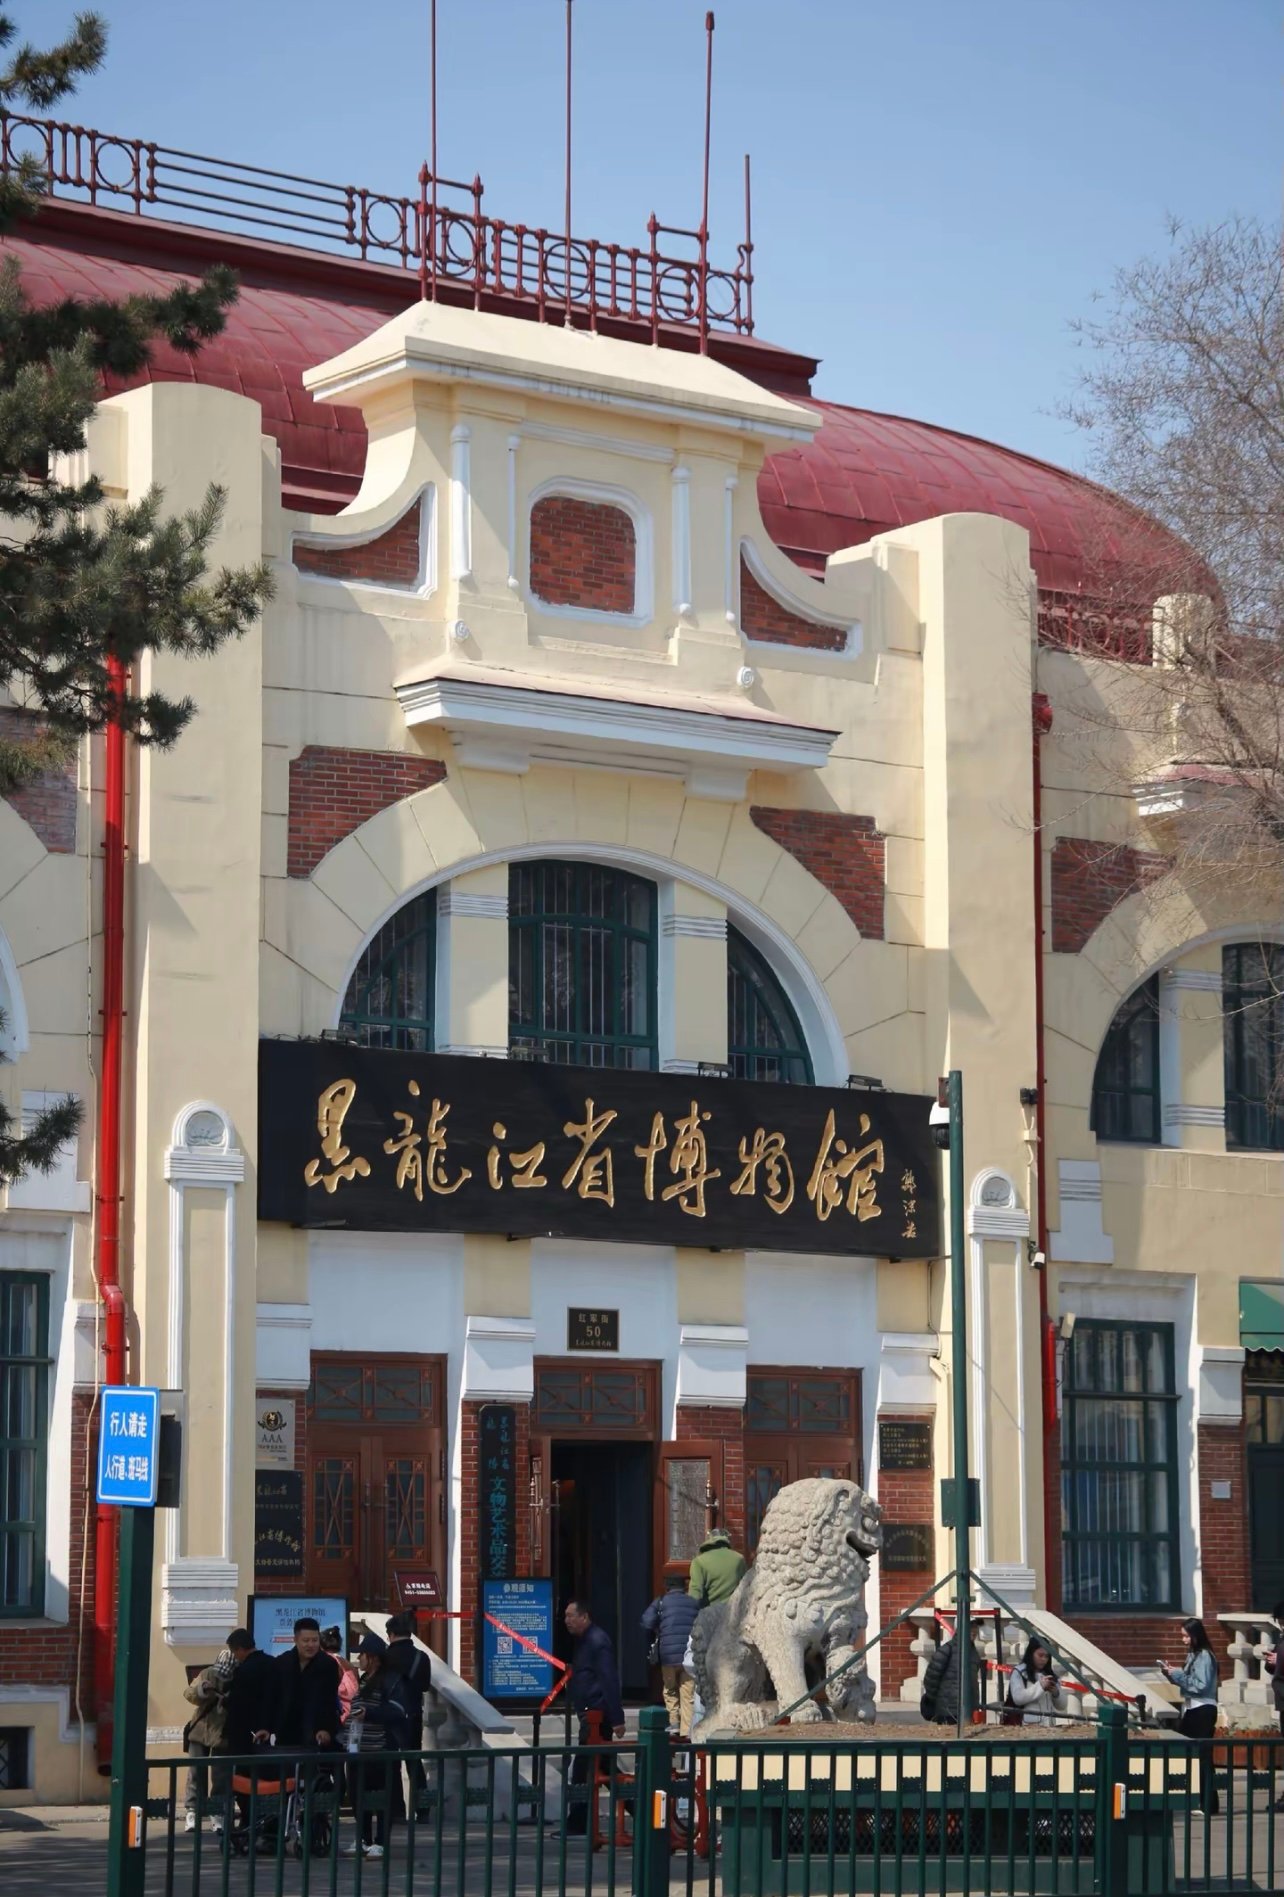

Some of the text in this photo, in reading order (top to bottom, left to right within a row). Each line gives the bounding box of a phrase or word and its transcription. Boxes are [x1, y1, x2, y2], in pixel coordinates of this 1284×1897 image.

[586, 1326, 601, 1337] 50
[110, 1411, 148, 1438] 行人请走
